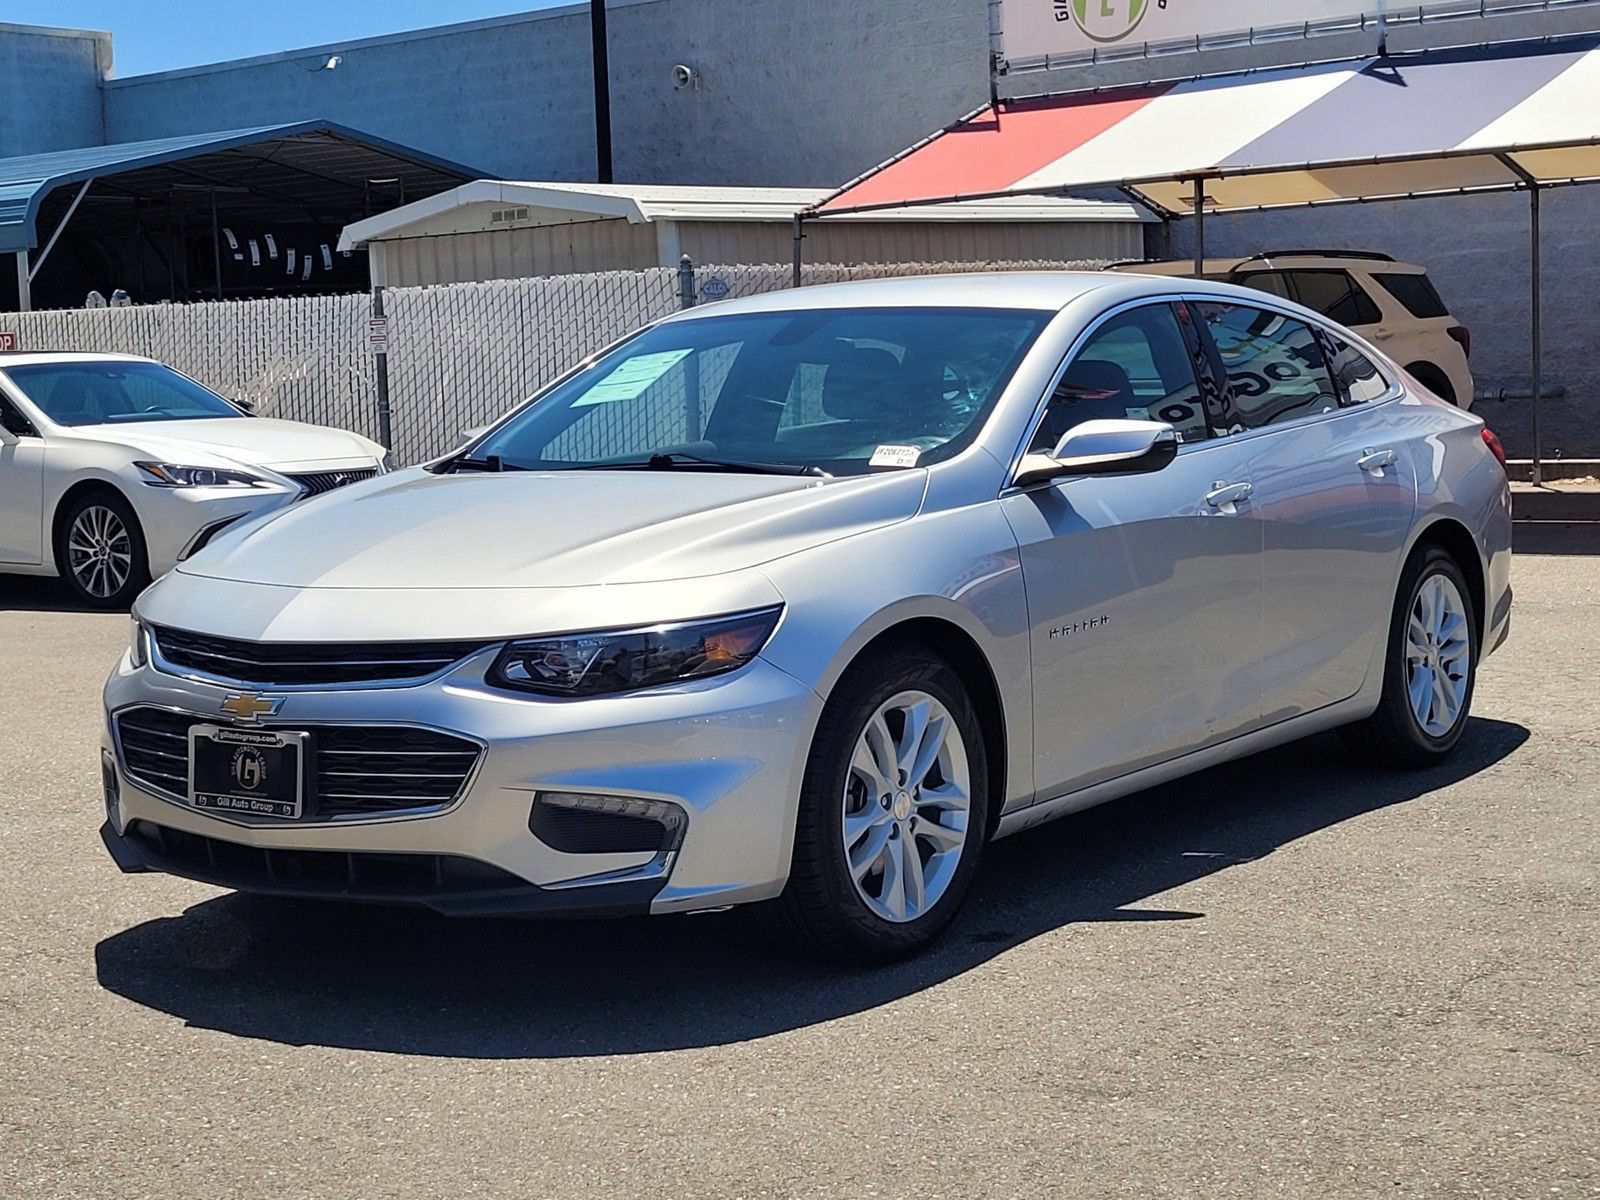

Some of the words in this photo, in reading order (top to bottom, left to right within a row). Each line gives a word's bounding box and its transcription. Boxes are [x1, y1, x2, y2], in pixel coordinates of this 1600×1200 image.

[219, 731, 277, 743] gillautogroup.com
[217, 797, 230, 806] Gill
[231, 799, 249, 809] Auto
[250, 801, 274, 812] Group
